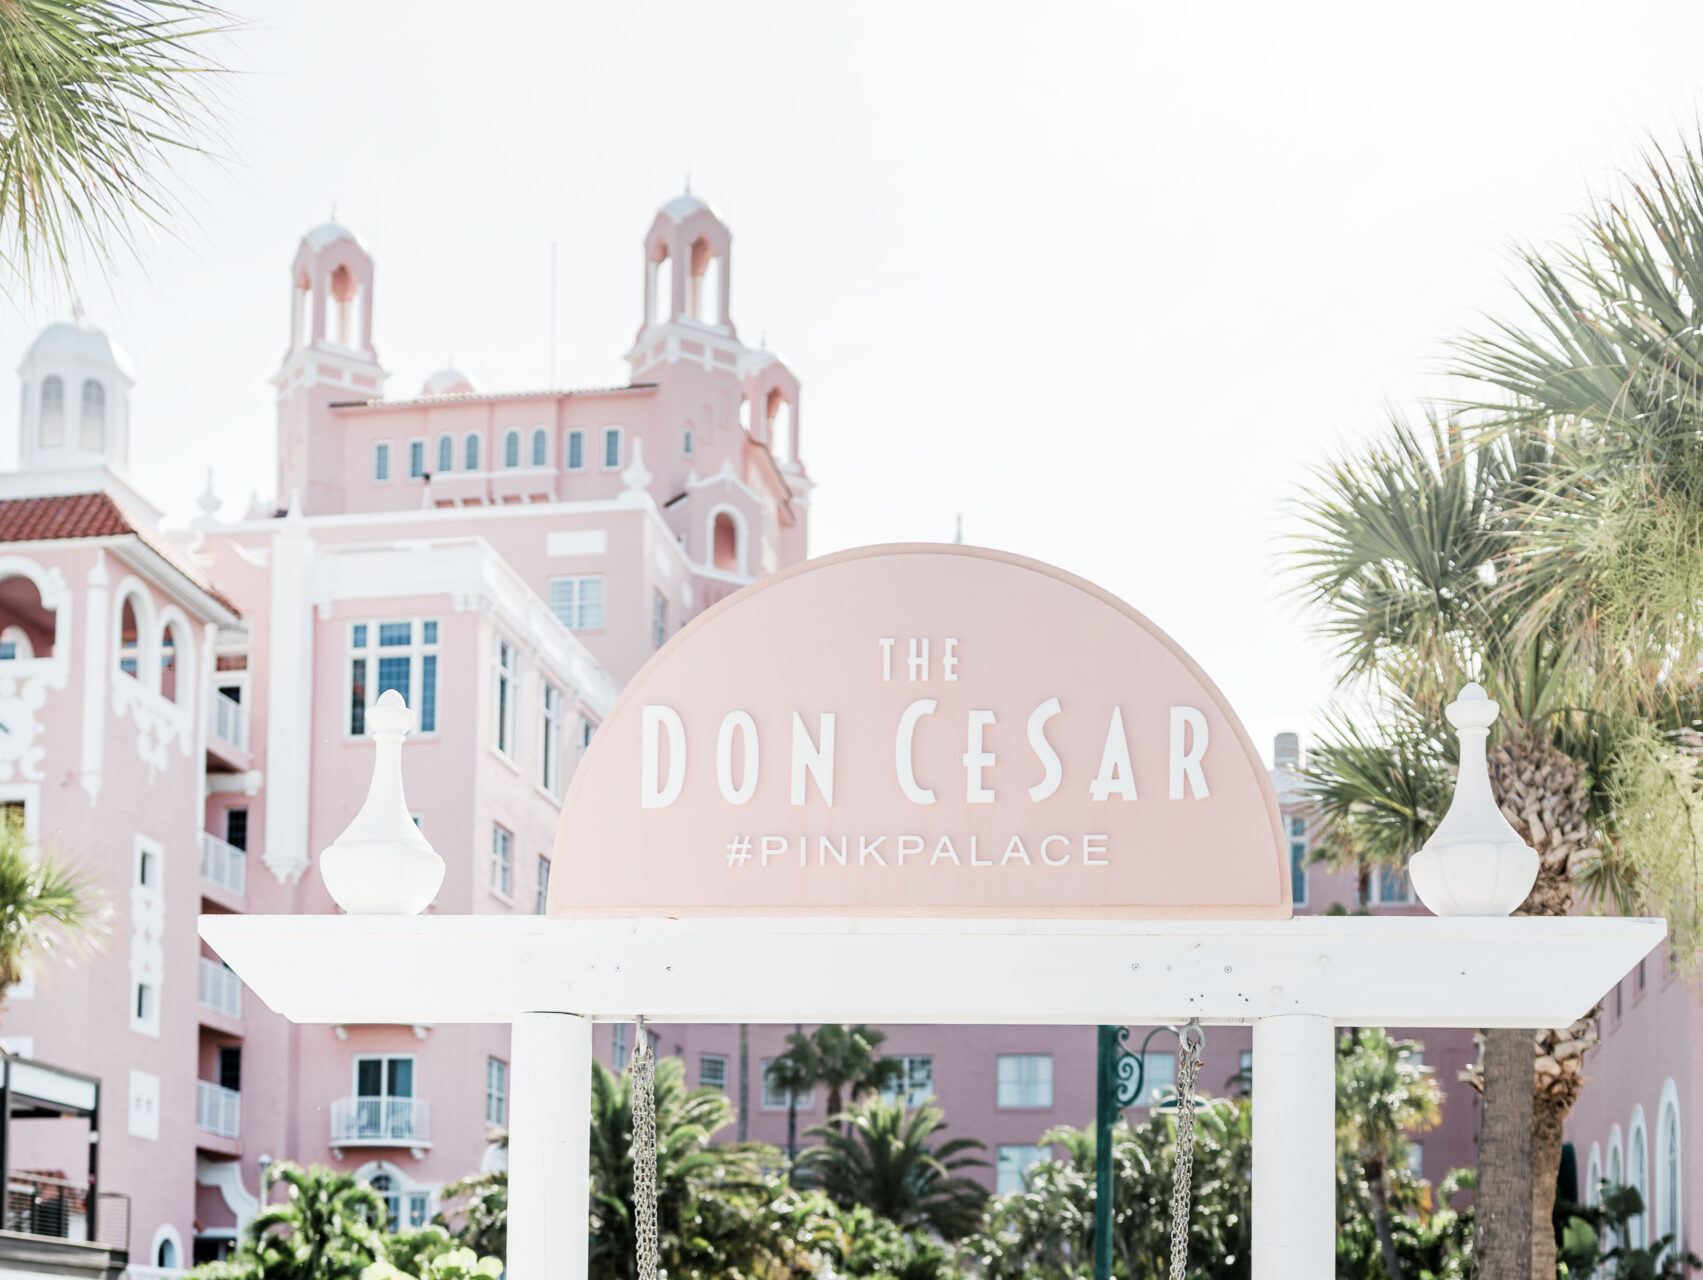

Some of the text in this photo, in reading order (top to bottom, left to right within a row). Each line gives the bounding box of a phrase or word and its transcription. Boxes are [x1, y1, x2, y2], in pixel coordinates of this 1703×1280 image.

[879, 637, 959, 682] THE
[641, 696, 1211, 809] DON CESAR
[725, 834, 1110, 868] #PINKPALACE
